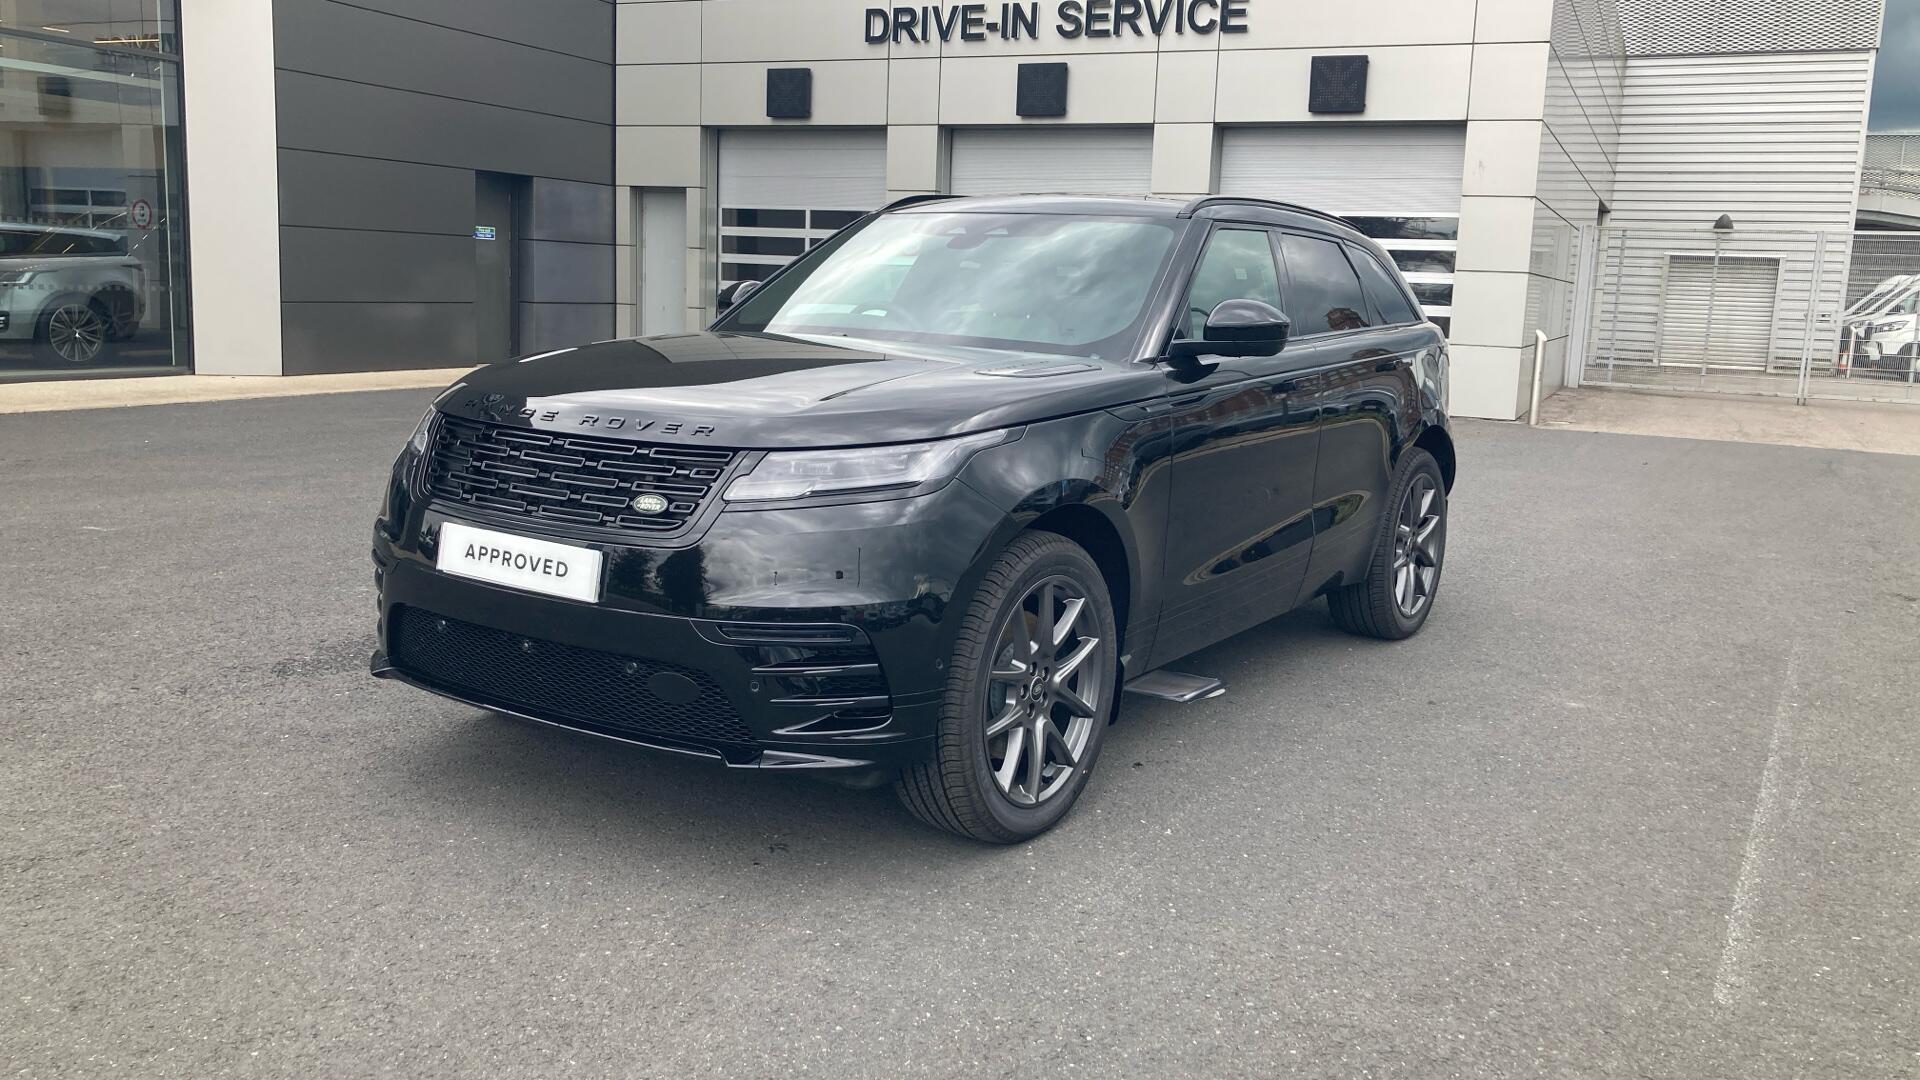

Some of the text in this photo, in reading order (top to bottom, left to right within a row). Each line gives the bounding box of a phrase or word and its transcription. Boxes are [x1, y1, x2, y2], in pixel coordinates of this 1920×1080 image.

[864, 0, 1249, 43] DRIVE-IN SERVICE
[464, 399, 715, 437] RNGE ROVER
[464, 543, 569, 578] APPROVED
